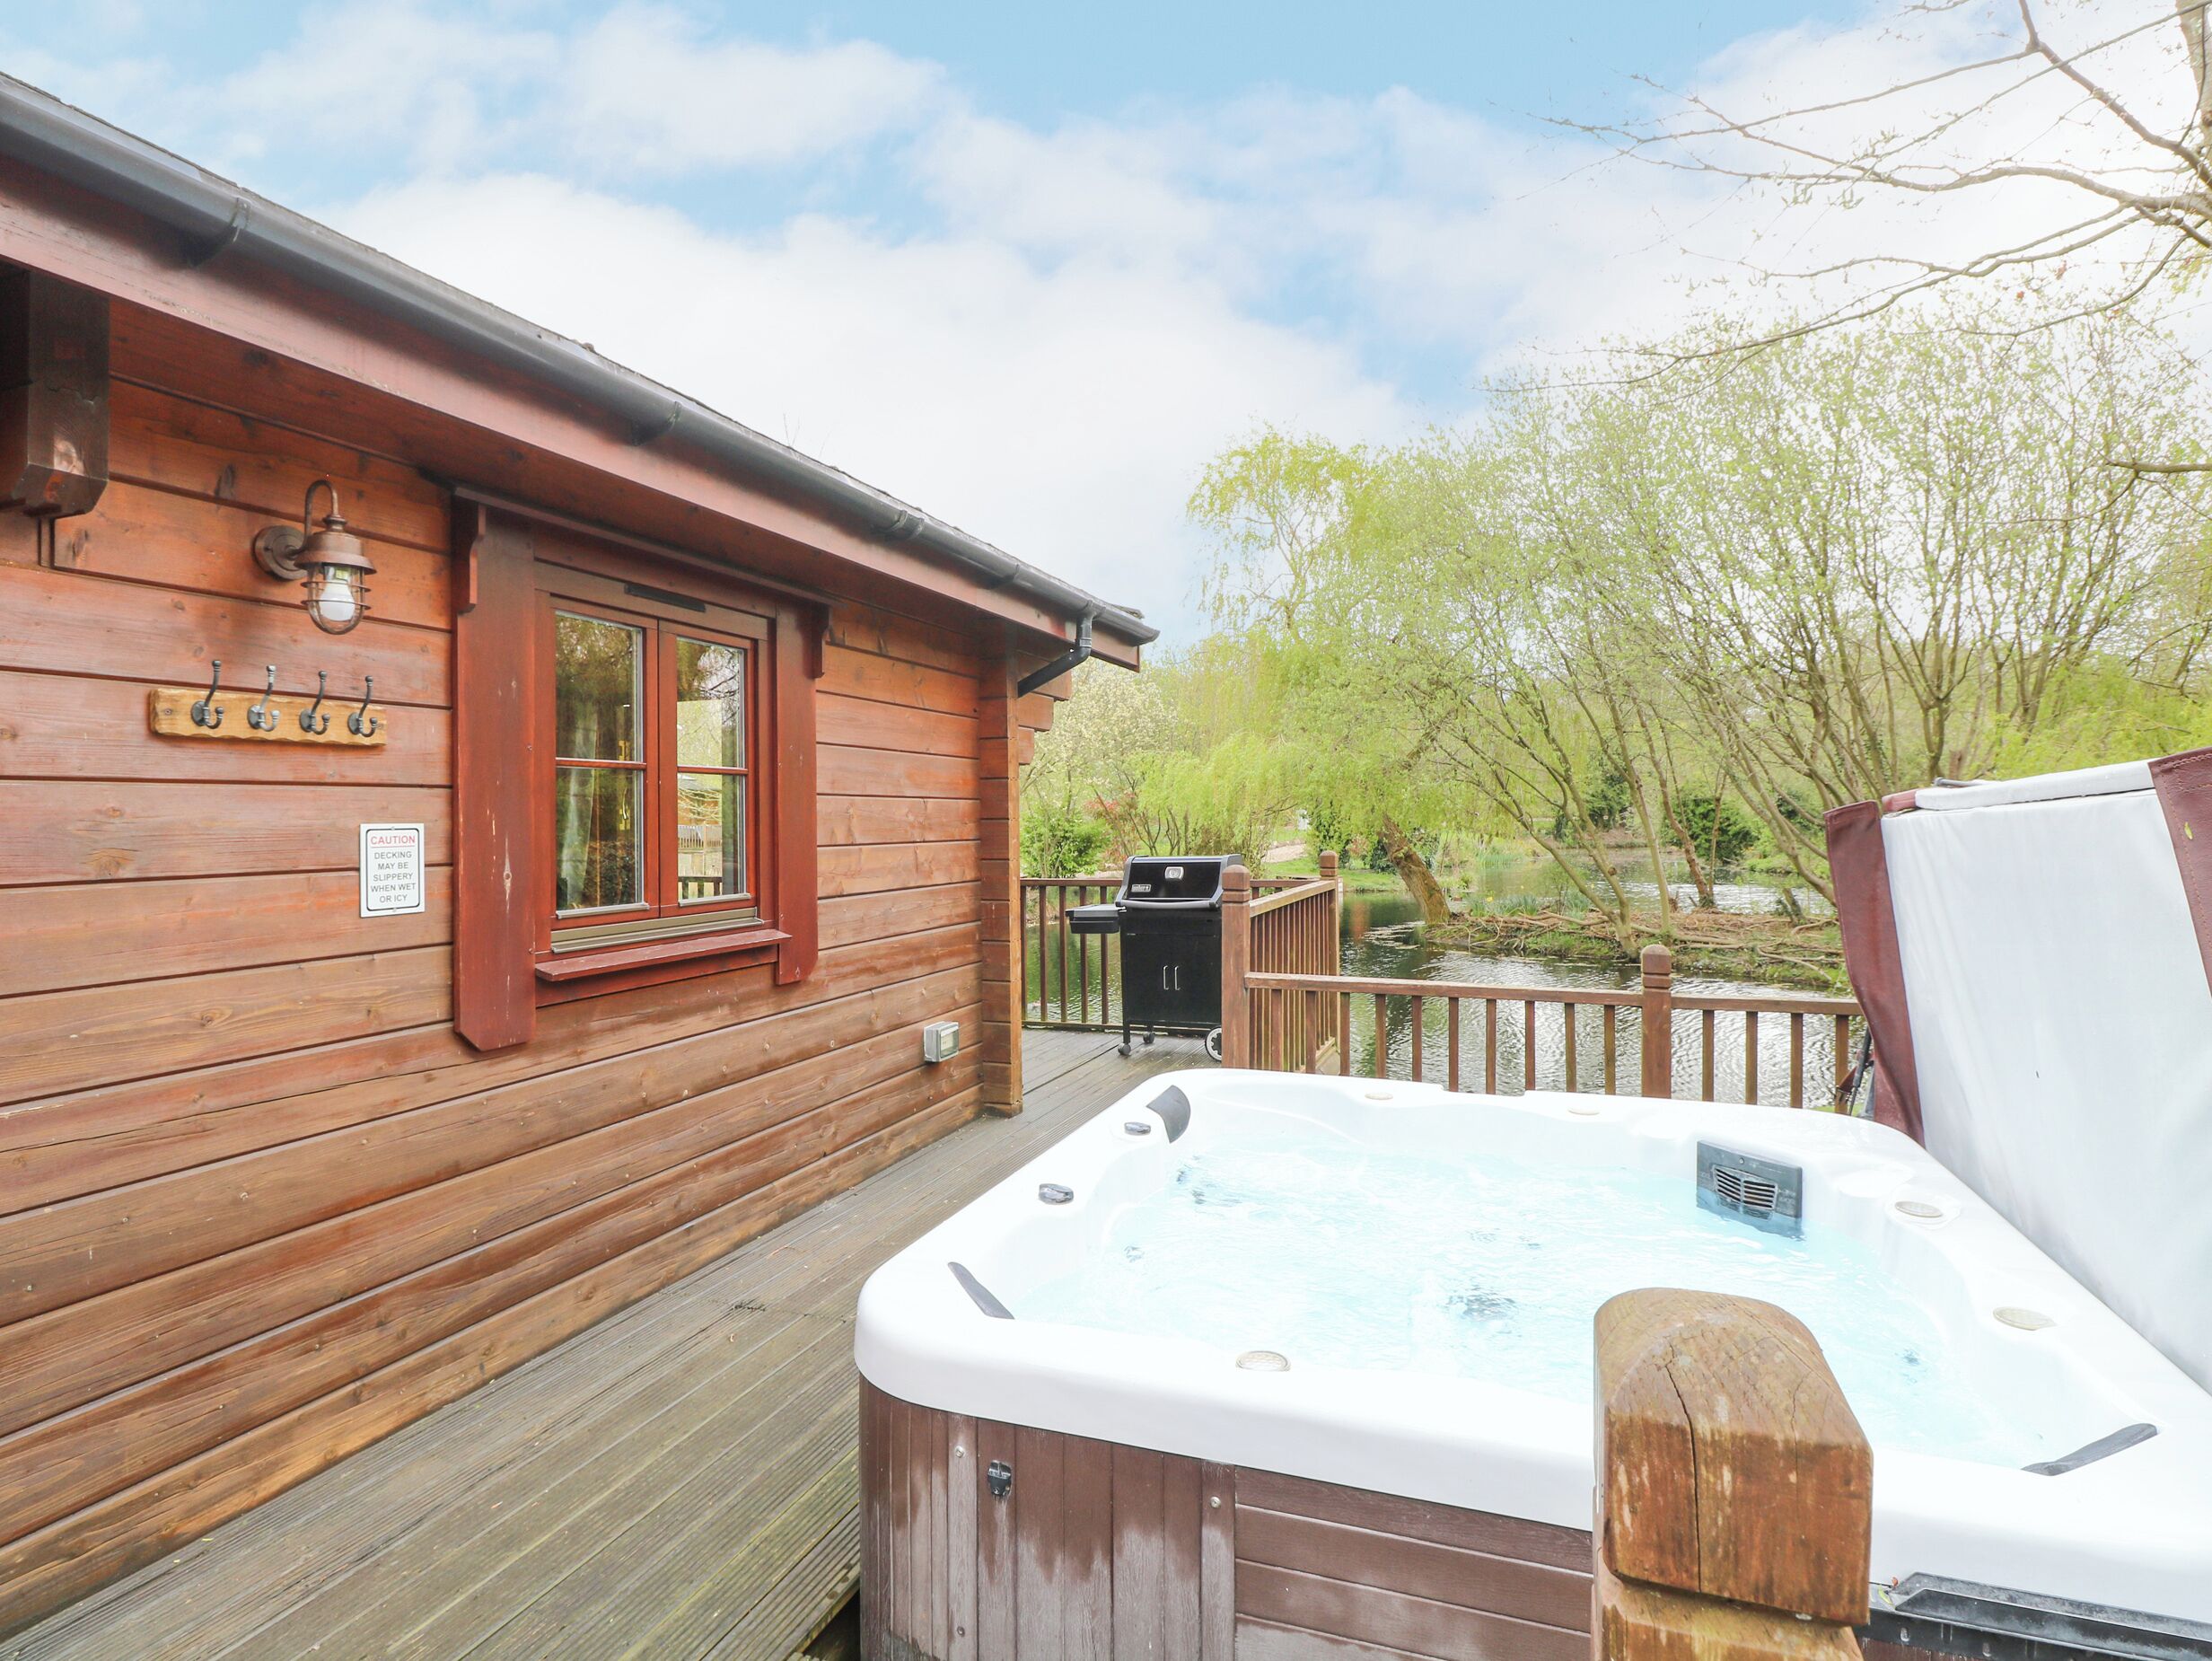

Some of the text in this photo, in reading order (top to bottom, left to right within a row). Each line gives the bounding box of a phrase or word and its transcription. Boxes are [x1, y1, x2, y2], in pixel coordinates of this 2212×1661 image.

[371, 835, 416, 845] CAUTION
[373, 851, 412, 859] DECKING
[377, 861, 409, 870] MAY BE
[373, 873, 413, 882] SLIPPERY
[370, 883, 416, 892] WHEN WET
[379, 894, 408, 903] OR ICY
